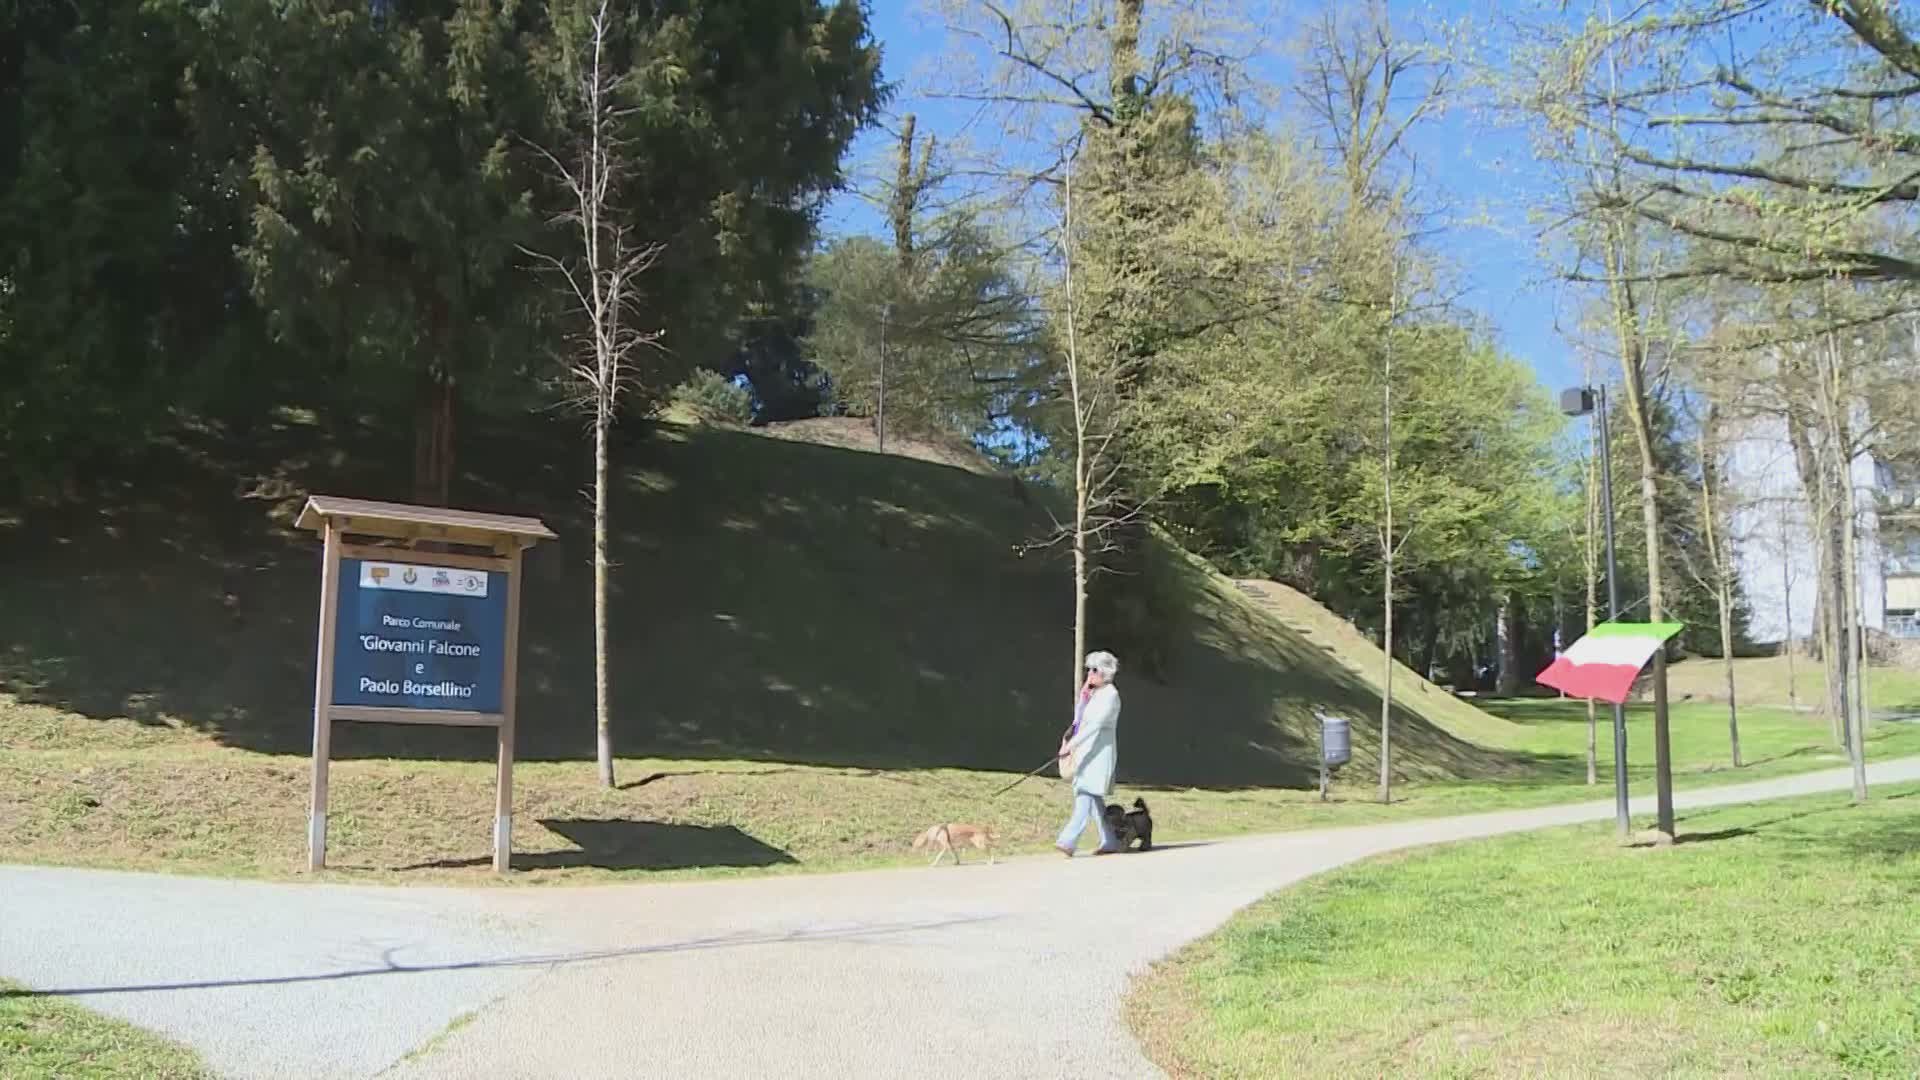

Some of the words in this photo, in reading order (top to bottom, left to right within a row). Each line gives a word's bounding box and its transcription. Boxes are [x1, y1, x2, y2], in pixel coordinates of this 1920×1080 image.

[383, 615, 410, 628] Parco
[412, 617, 461, 631] Comunale
[428, 640, 480, 656] Falcone
[415, 663, 425, 674] e
[360, 677, 399, 694] Paolo
